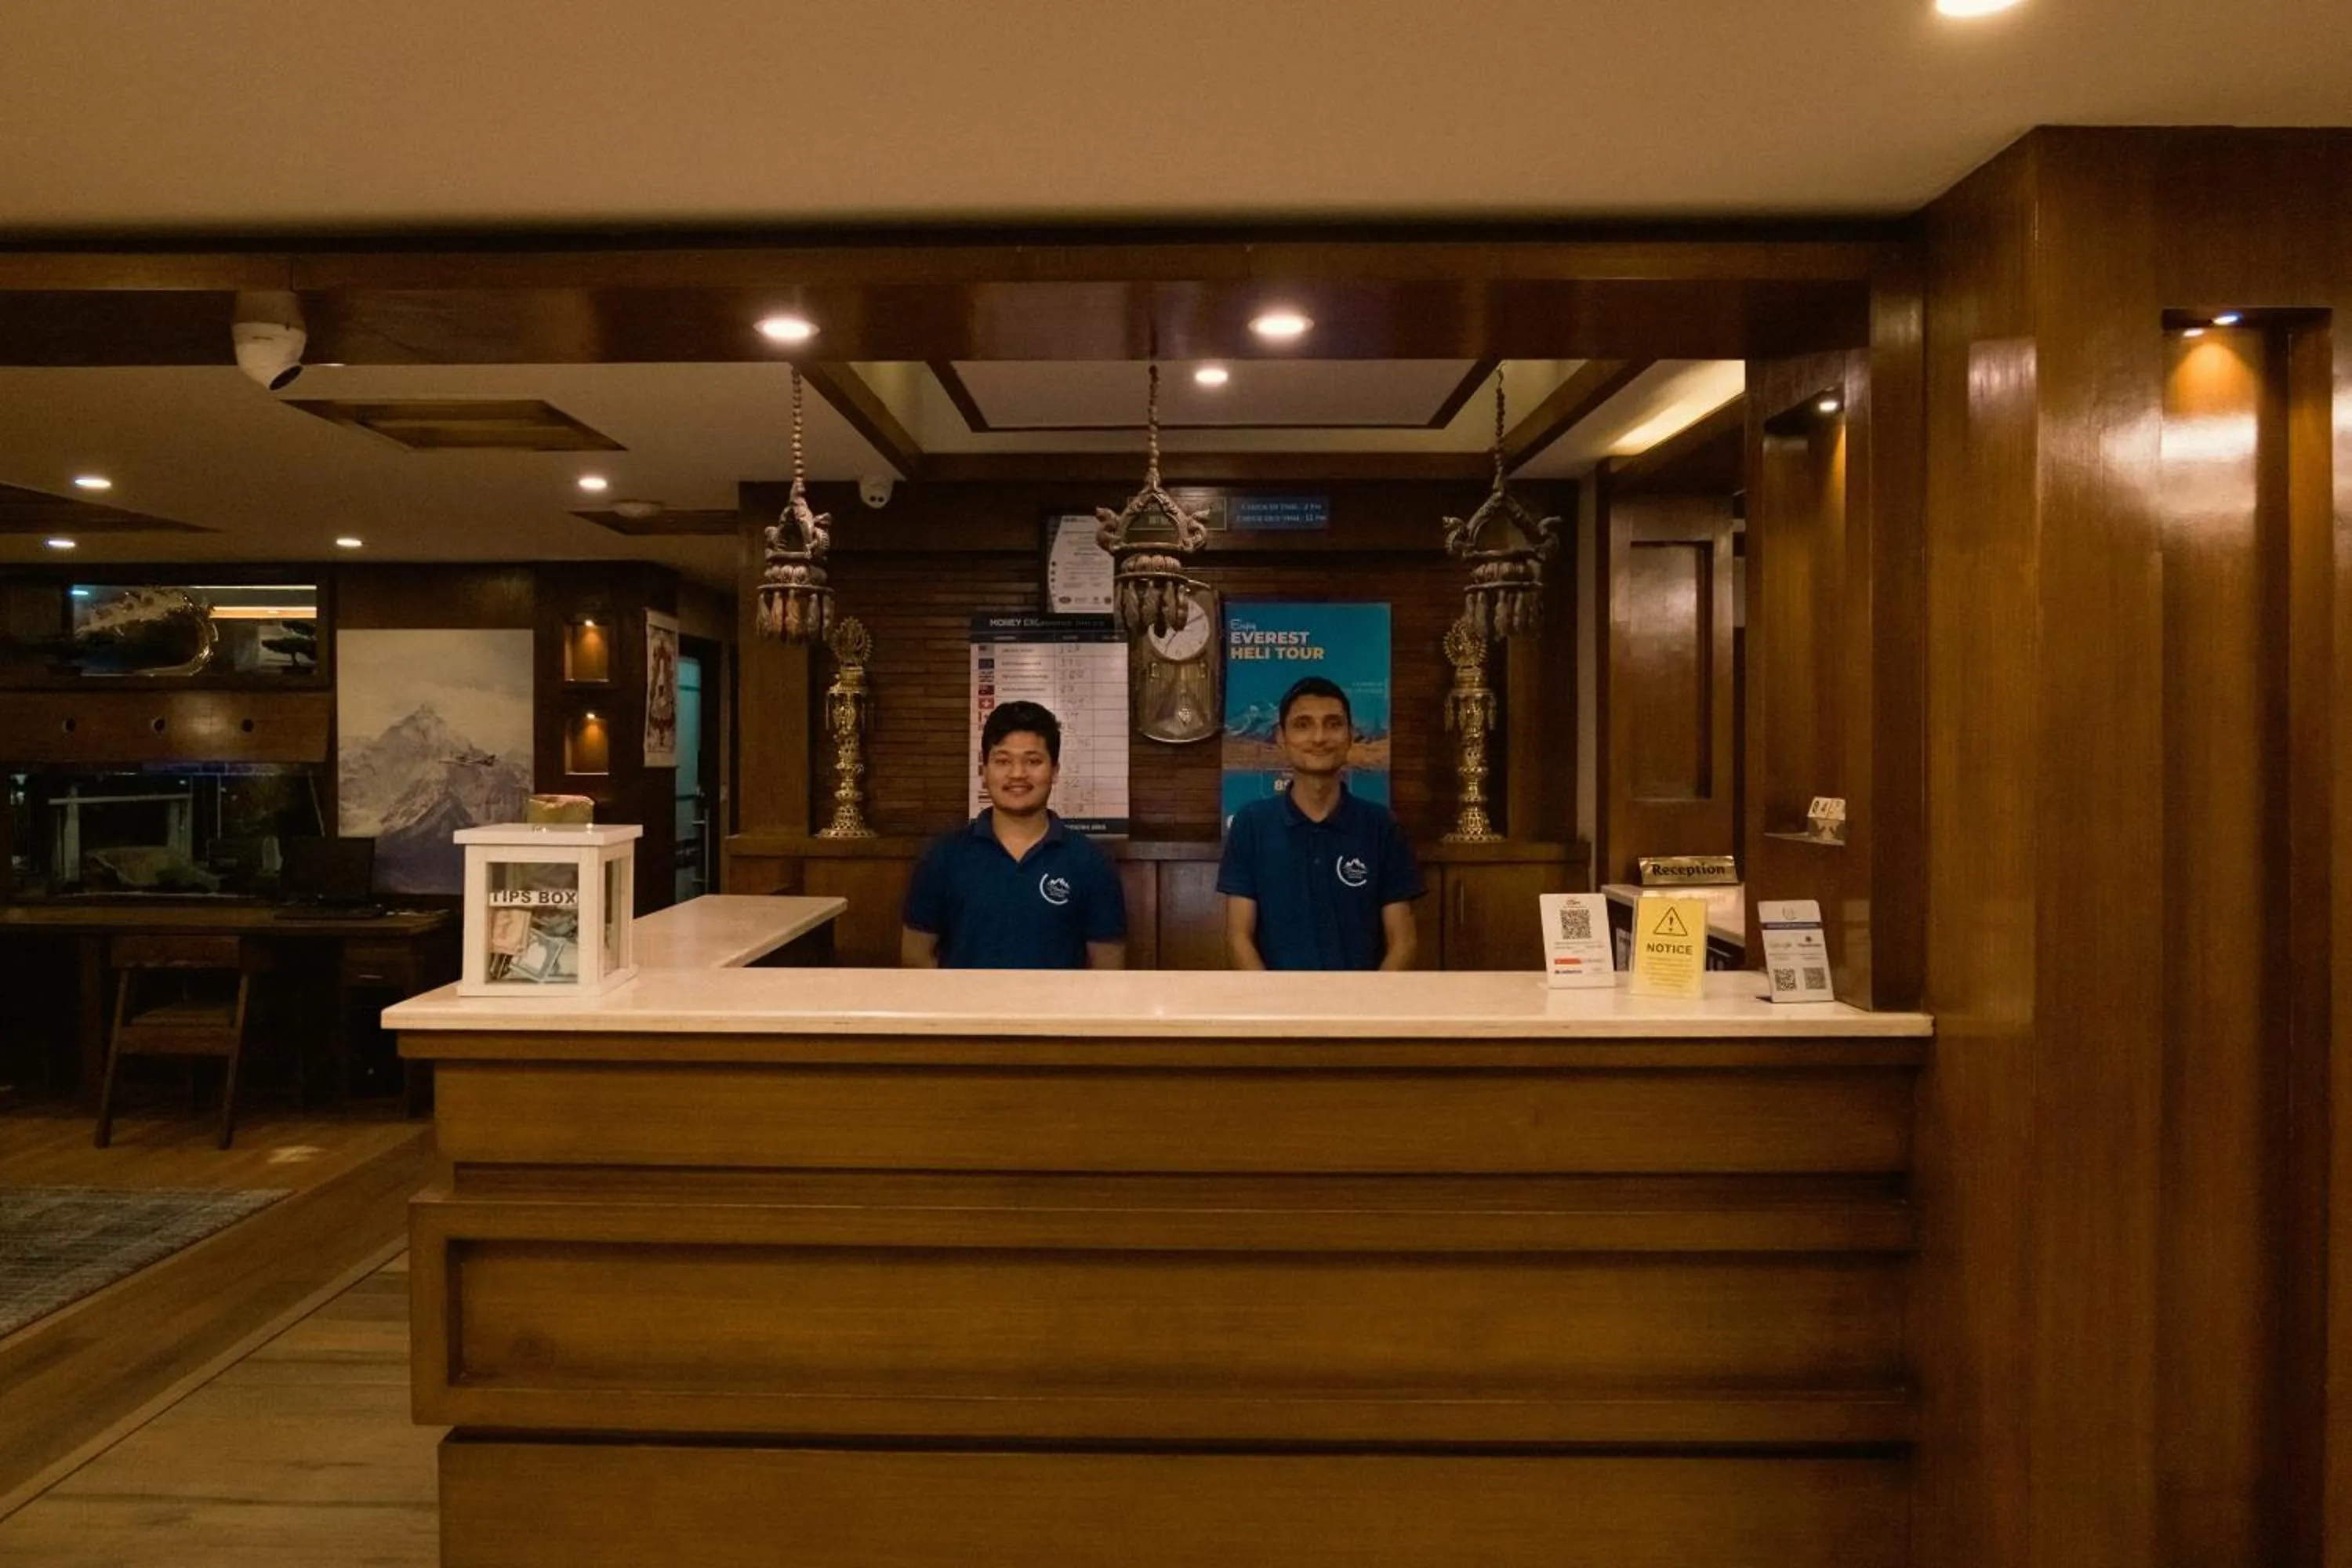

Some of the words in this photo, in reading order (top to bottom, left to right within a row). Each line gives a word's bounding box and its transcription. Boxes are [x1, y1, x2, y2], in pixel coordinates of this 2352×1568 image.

[989, 618, 1022, 627] MONEY
[1230, 631, 1310, 644] EVEREST
[1230, 647, 1271, 659] HELI
[1274, 647, 1325, 659] TOUR
[1652, 863, 1725, 877] Reception
[492, 890, 532, 903] TIPS
[539, 891, 576, 904] BOX
[1646, 942, 1693, 955] NOTICE
